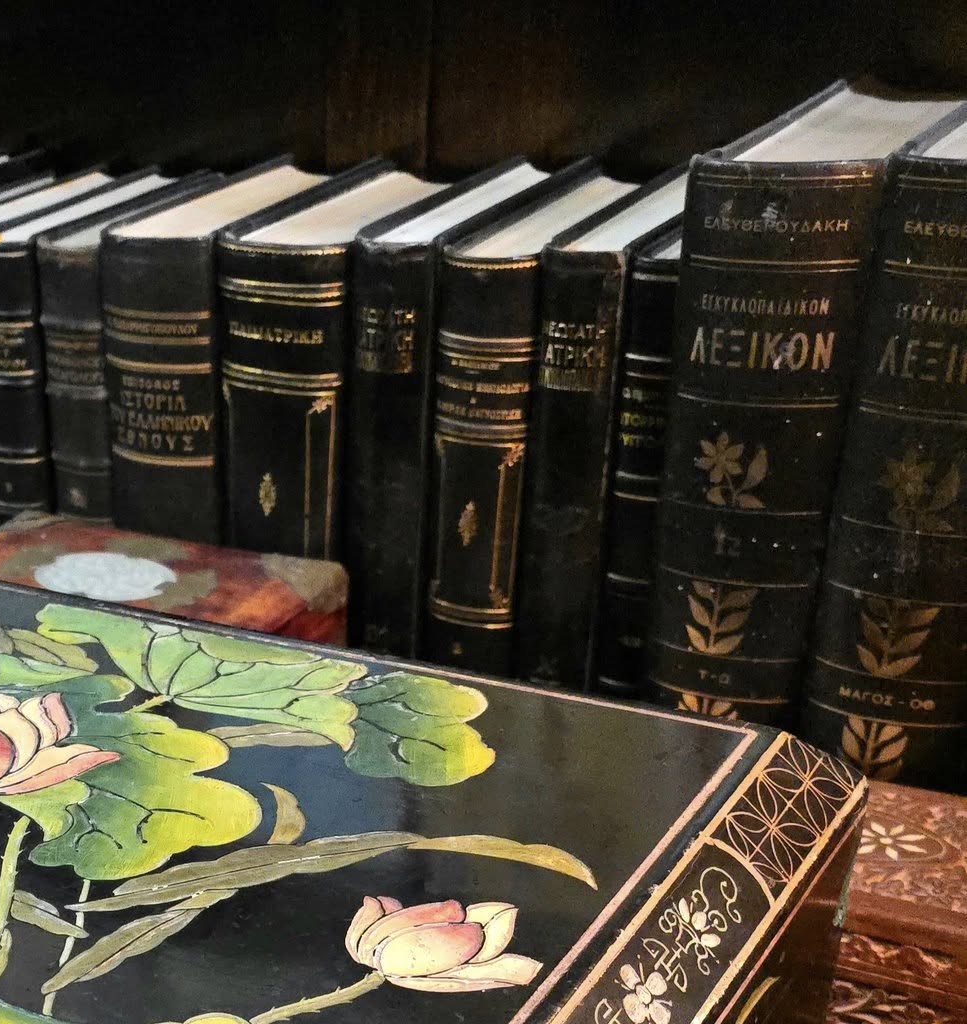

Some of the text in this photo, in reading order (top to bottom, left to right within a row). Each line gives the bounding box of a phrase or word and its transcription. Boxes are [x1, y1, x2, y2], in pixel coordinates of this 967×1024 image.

[703, 215, 849, 233] ΕΛΕΥΘΕΡΟΥΔΑΚΗ
[689, 326, 836, 372] ΛΕΞΙΚΟΝ
[839, 684, 893, 707] ΜΑΓΟΣ
